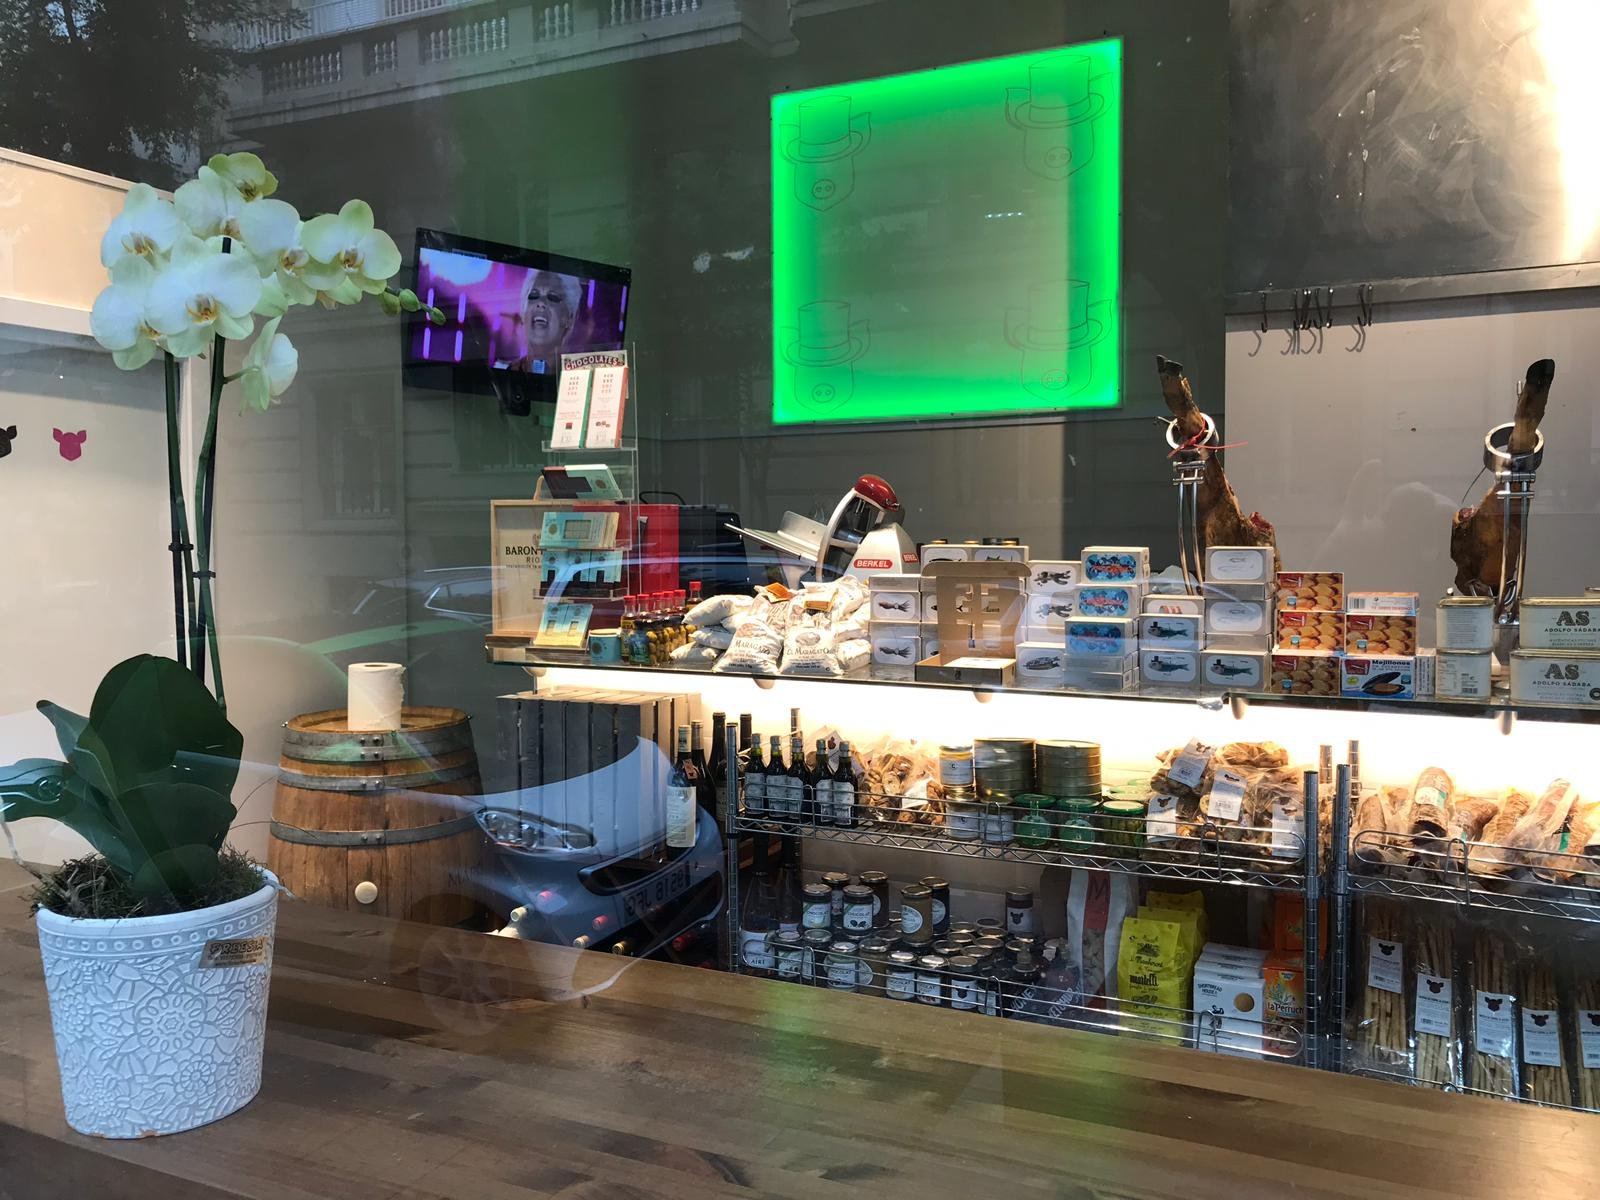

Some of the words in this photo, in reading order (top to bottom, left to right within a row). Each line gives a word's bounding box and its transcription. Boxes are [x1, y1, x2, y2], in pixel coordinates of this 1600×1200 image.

[565, 355, 618, 370] CHOCOLATES
[505, 546, 538, 556] BARON
[526, 556, 540, 564] RIO
[856, 560, 889, 568] BERKEL
[1556, 610, 1590, 626] AS
[1544, 663, 1579, 680] AS
[1274, 1003, 1305, 1014] Perruch
